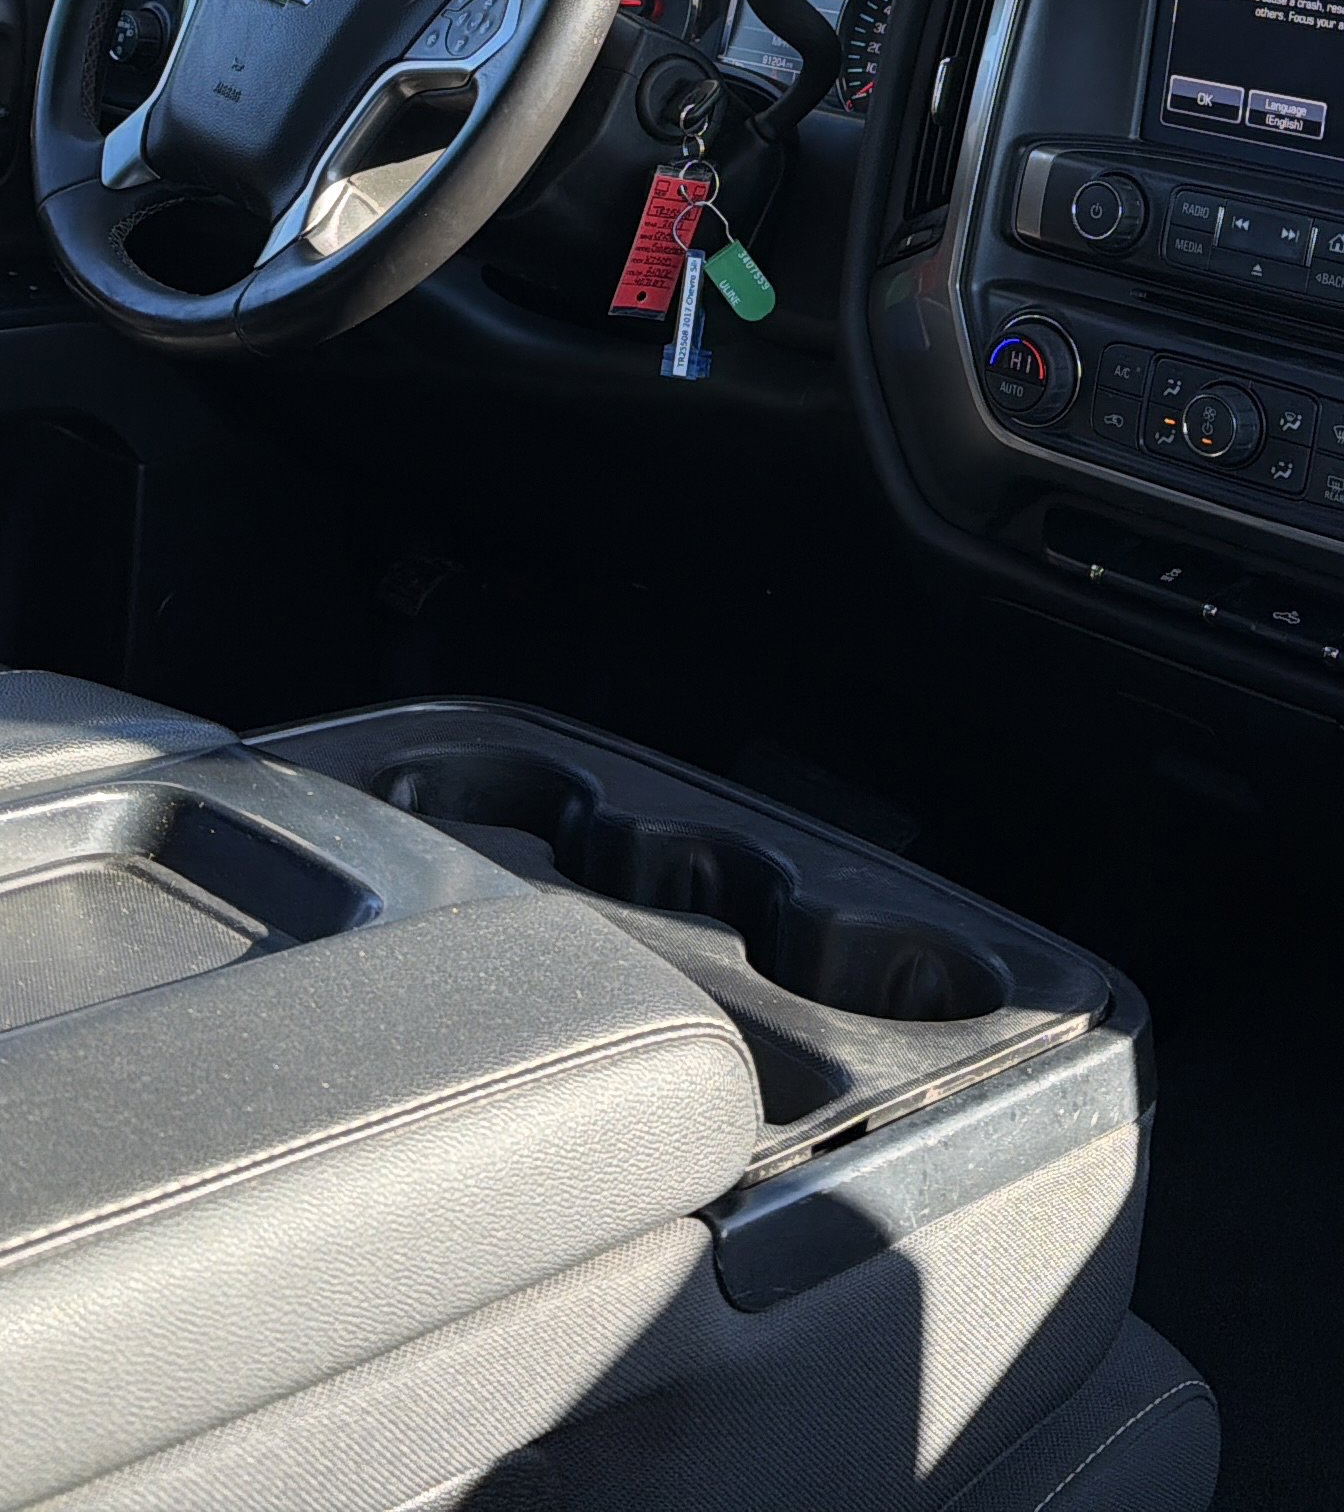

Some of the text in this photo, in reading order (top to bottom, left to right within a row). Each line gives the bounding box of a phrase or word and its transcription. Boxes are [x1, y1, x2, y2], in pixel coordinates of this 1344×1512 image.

[1297, 0, 1325, 13] crash,
[1255, 7, 1286, 21] others.
[1288, 11, 1315, 26] Focus
[1316, 17, 1336, 29] your
[762, 55, 786, 68] 91204
[1197, 92, 1214, 107] OK
[1265, 99, 1307, 118] Language
[1265, 114, 1303, 132] (English)
[1182, 202, 1210, 219] RADIO
[1175, 237, 1203, 255] MEDIA
[737, 250, 771, 291] 3407559
[719, 279, 742, 307] ULINE
[682, 308, 693, 329] 2017
[1010, 350, 1032, 375] HI
[1114, 365, 1131, 380] A/C
[1000, 381, 1024, 398] AUTO
[1324, 489, 1344, 504] REAR
